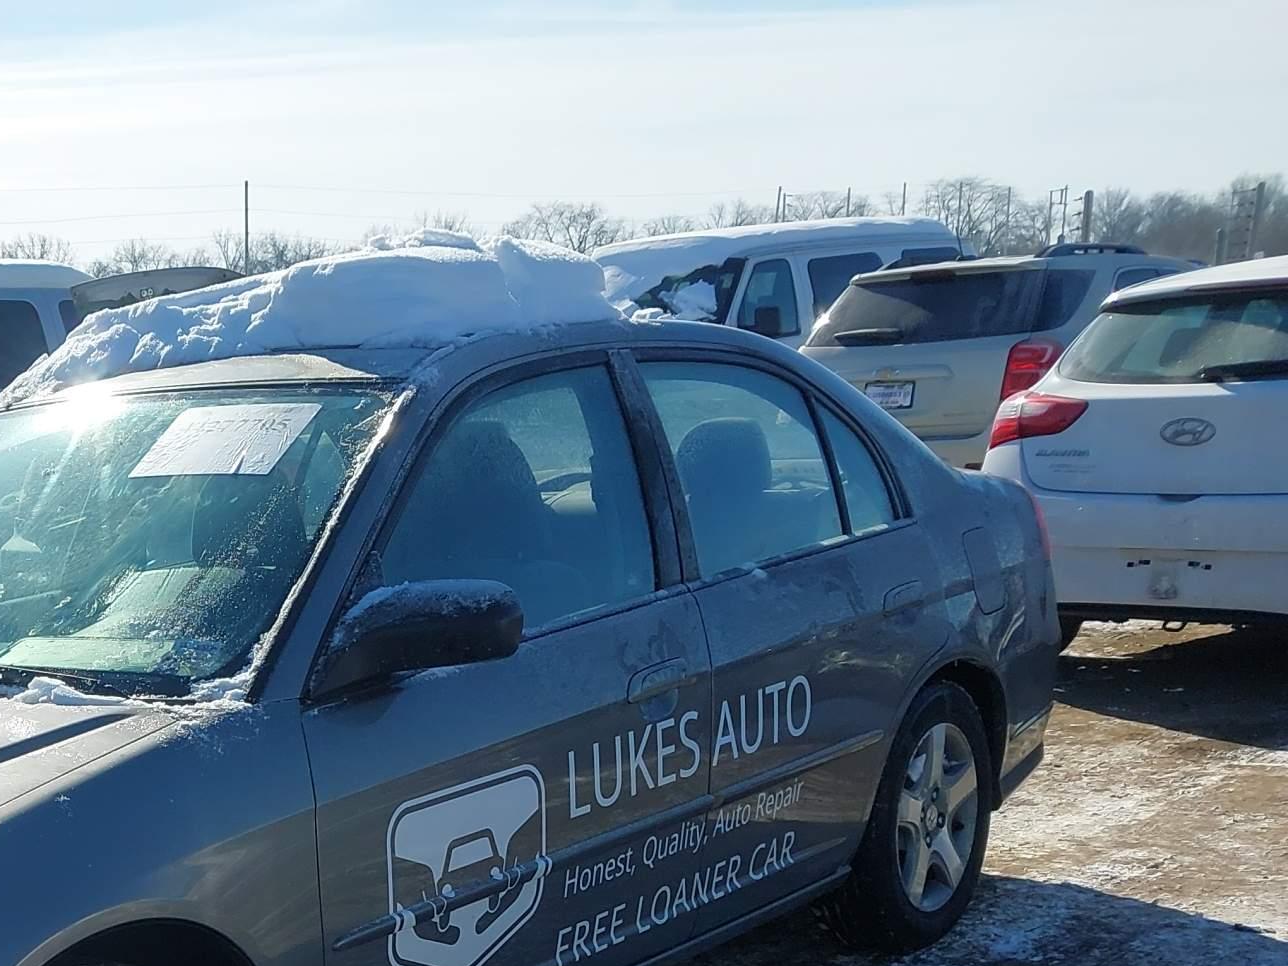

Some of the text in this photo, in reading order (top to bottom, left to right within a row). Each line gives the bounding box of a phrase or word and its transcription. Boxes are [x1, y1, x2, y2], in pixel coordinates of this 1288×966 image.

[567, 675, 811, 819] LUKES AUTO
[563, 779, 805, 899] Honest, Quality, Auto Repair
[635, 855, 741, 934] LOANER
[748, 831, 795, 881] CAR
